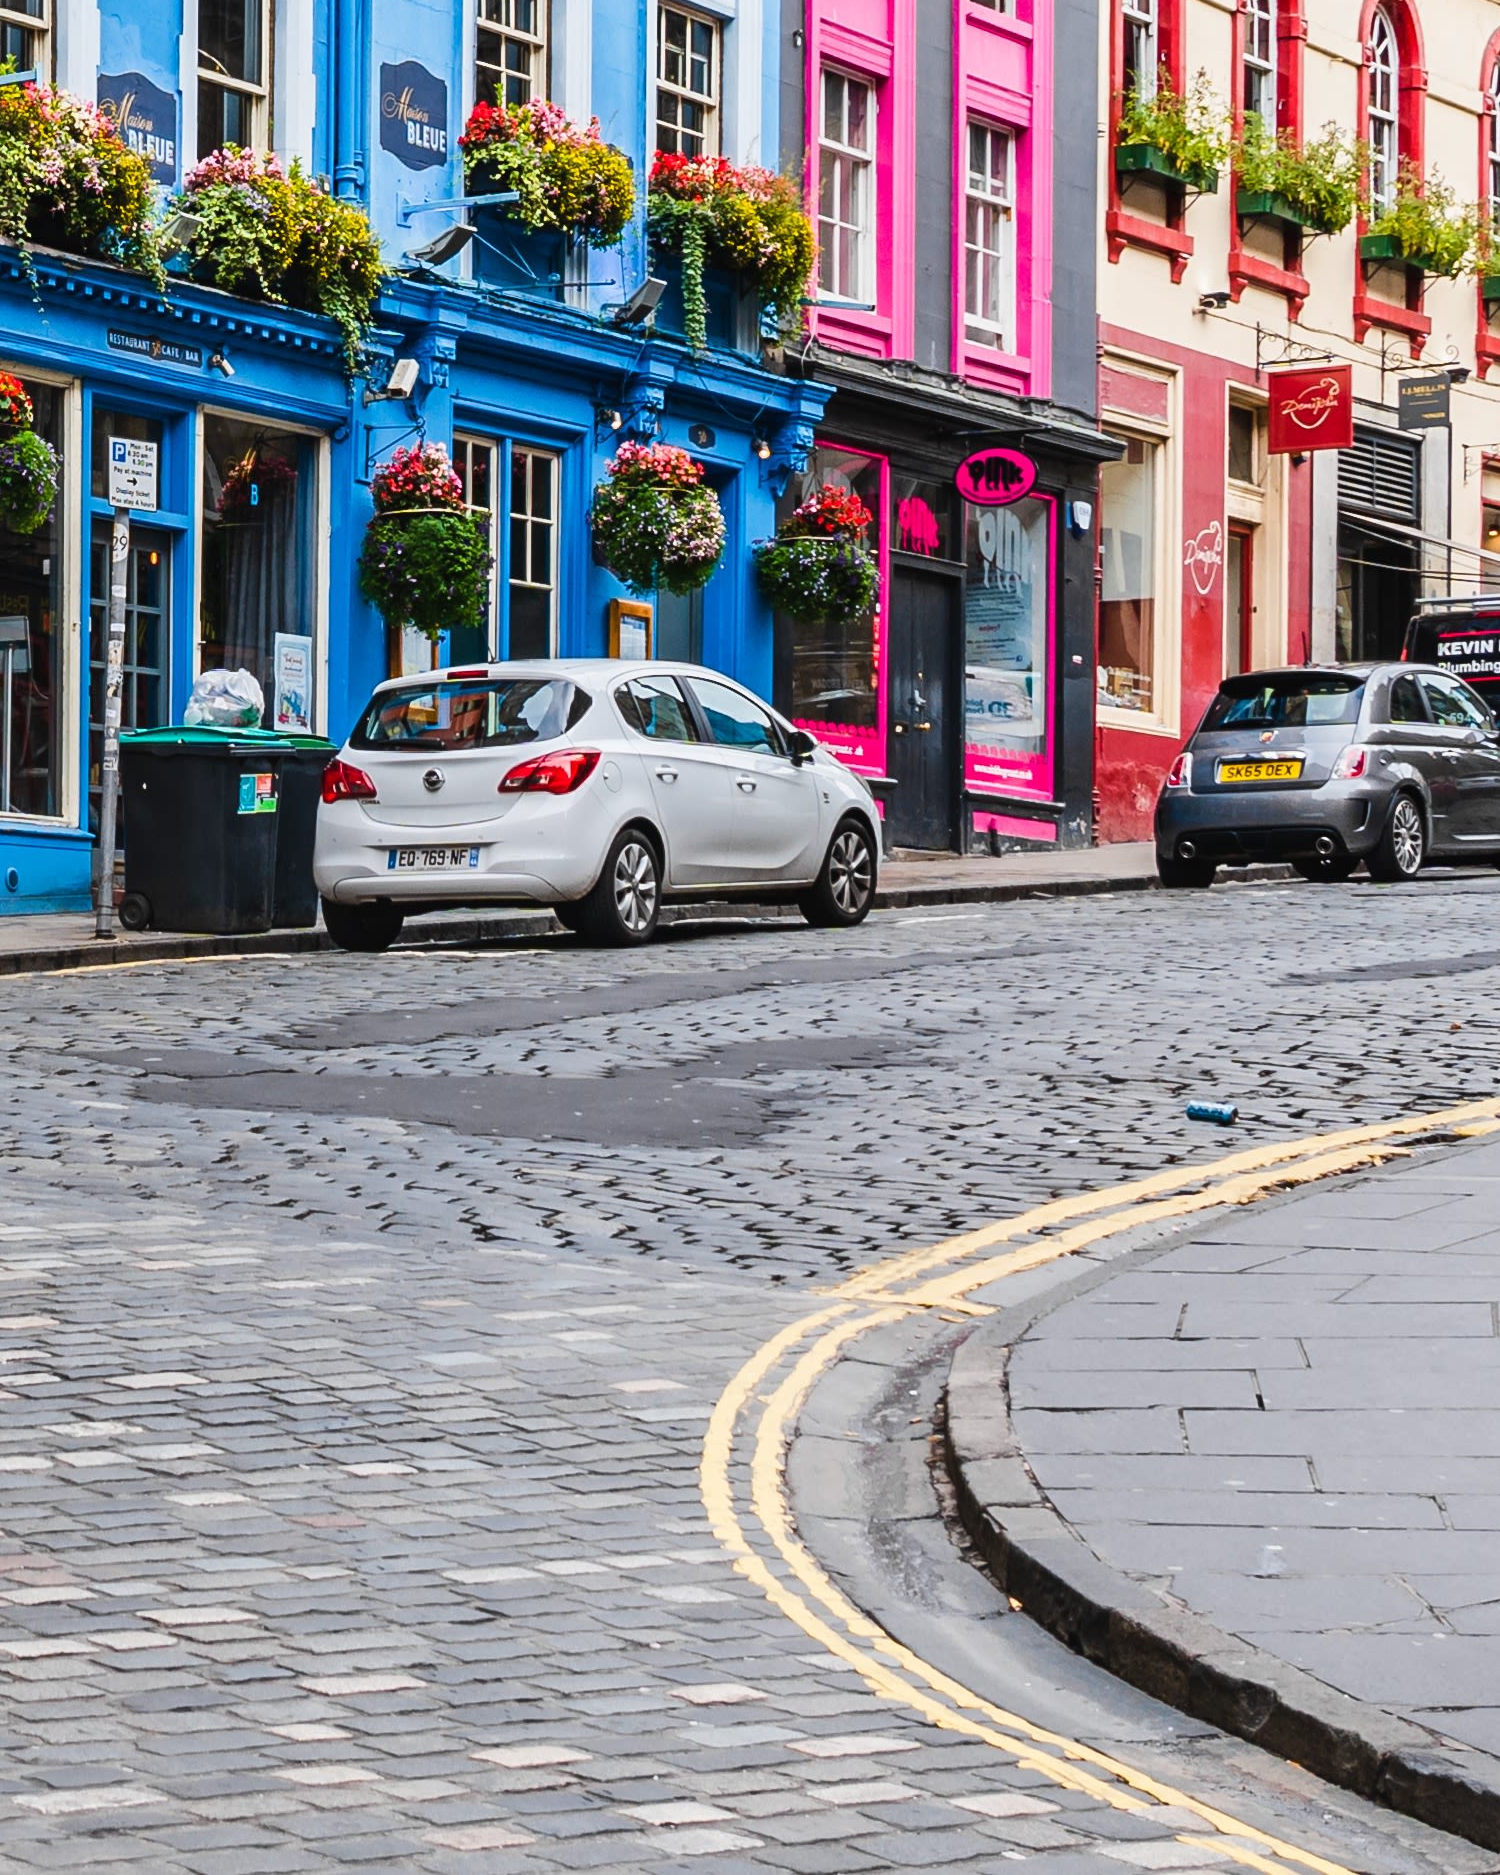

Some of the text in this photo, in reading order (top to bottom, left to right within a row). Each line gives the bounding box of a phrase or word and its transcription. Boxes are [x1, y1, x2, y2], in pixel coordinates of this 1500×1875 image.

[407, 120, 446, 153] BLEUE
[109, 332, 200, 363] RESTAURANT CAFE BAR
[114, 443, 125, 460] P
[1437, 639, 1494, 657] KEVIN
[1227, 765, 1295, 779] SK65 OEX
